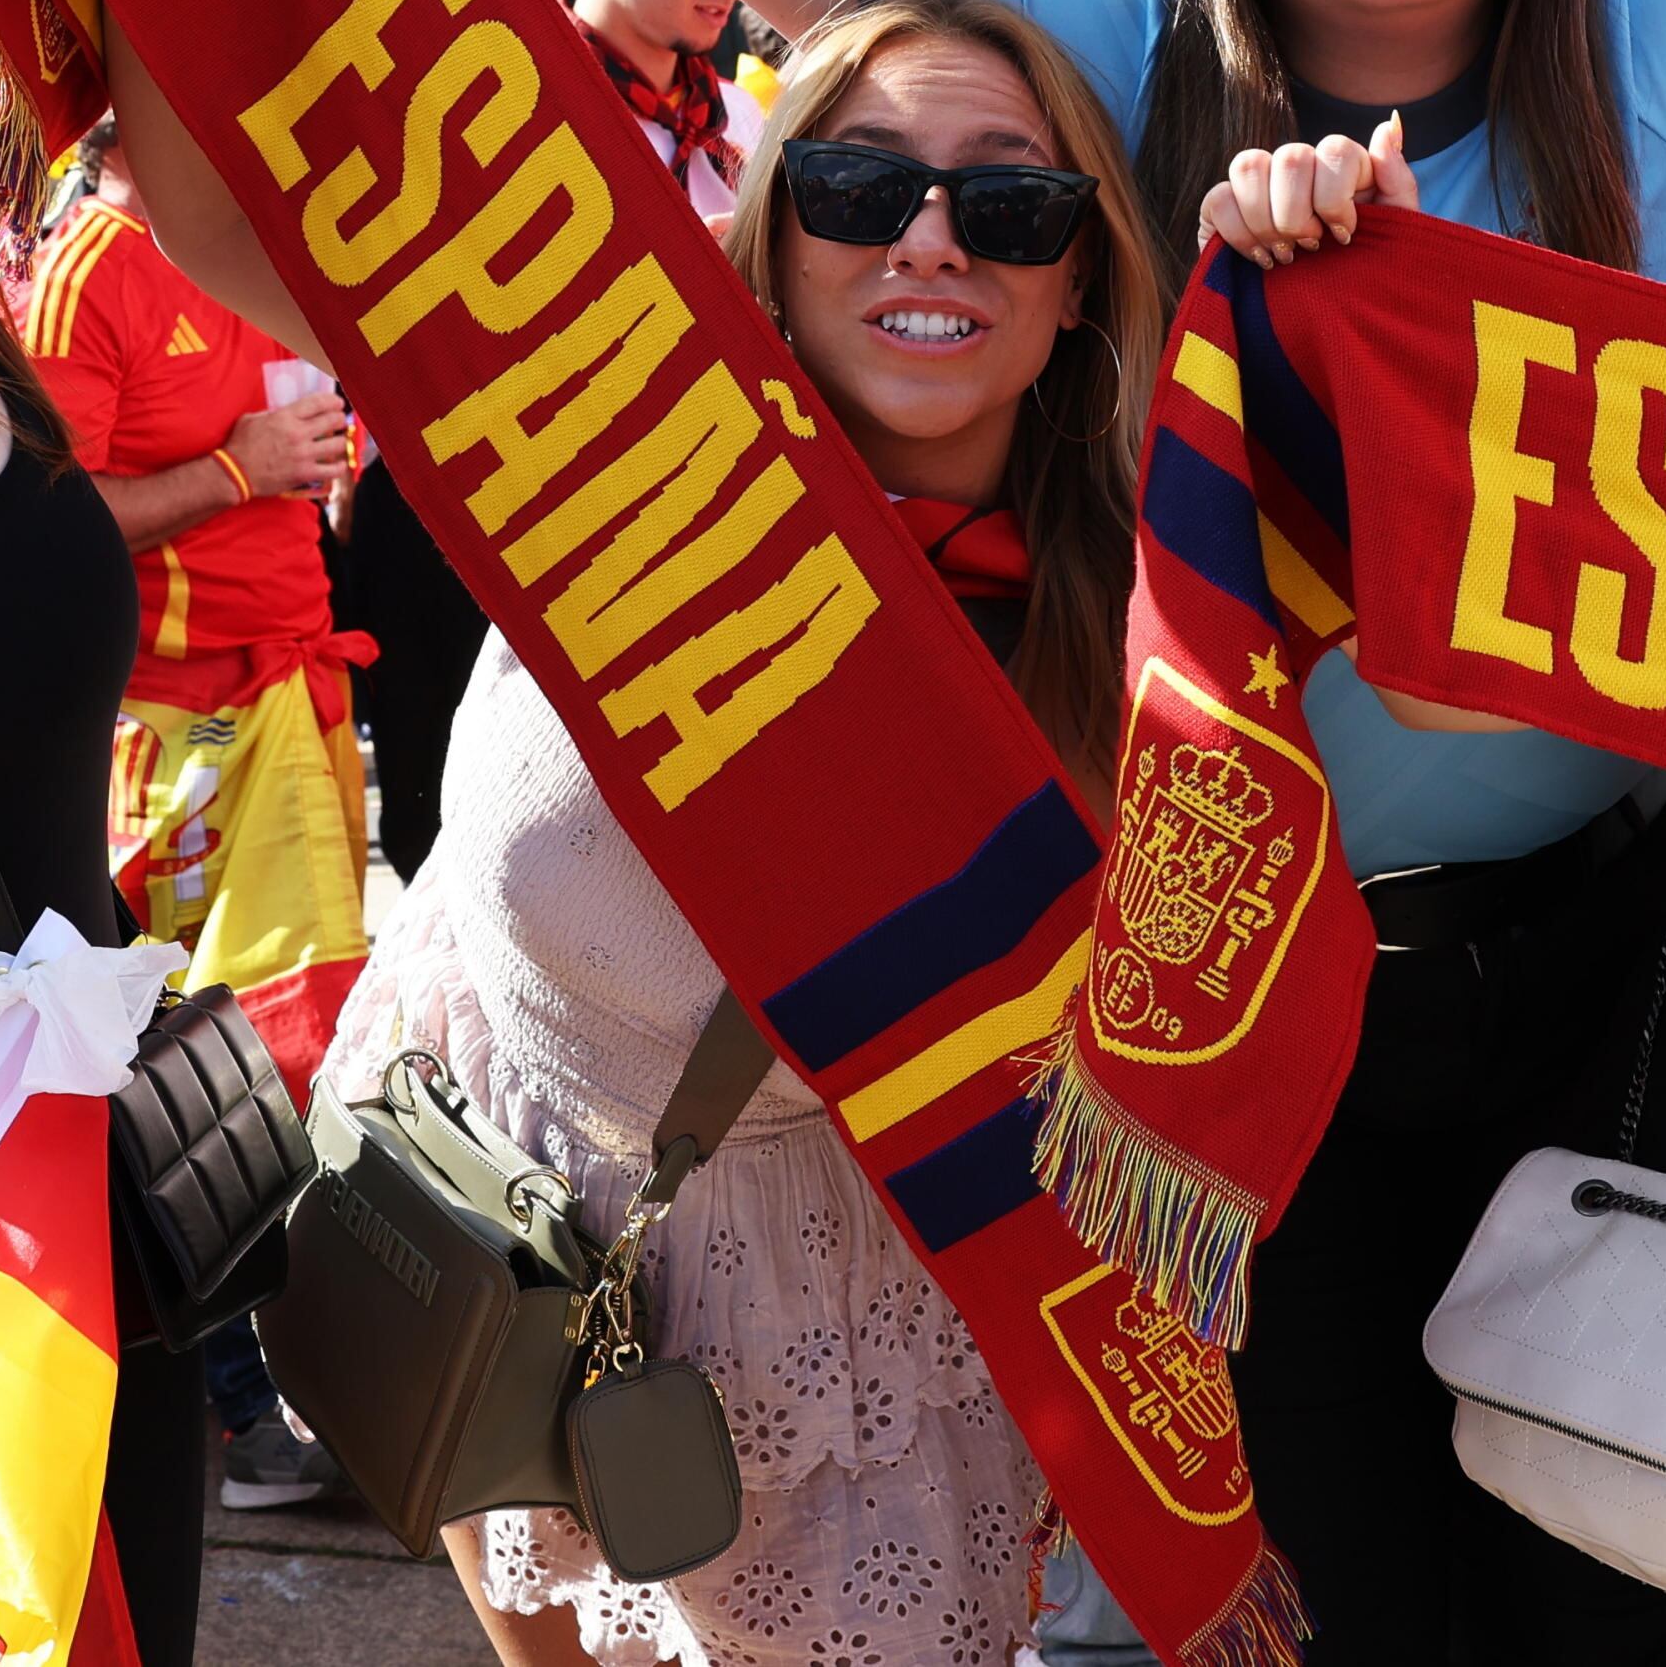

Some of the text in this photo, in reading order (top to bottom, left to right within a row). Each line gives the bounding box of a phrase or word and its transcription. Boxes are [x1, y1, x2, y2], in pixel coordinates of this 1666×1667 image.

[1115, 957, 1144, 992] RF
[1106, 981, 1134, 1015] EF
[1151, 1007, 1183, 1042] 09
